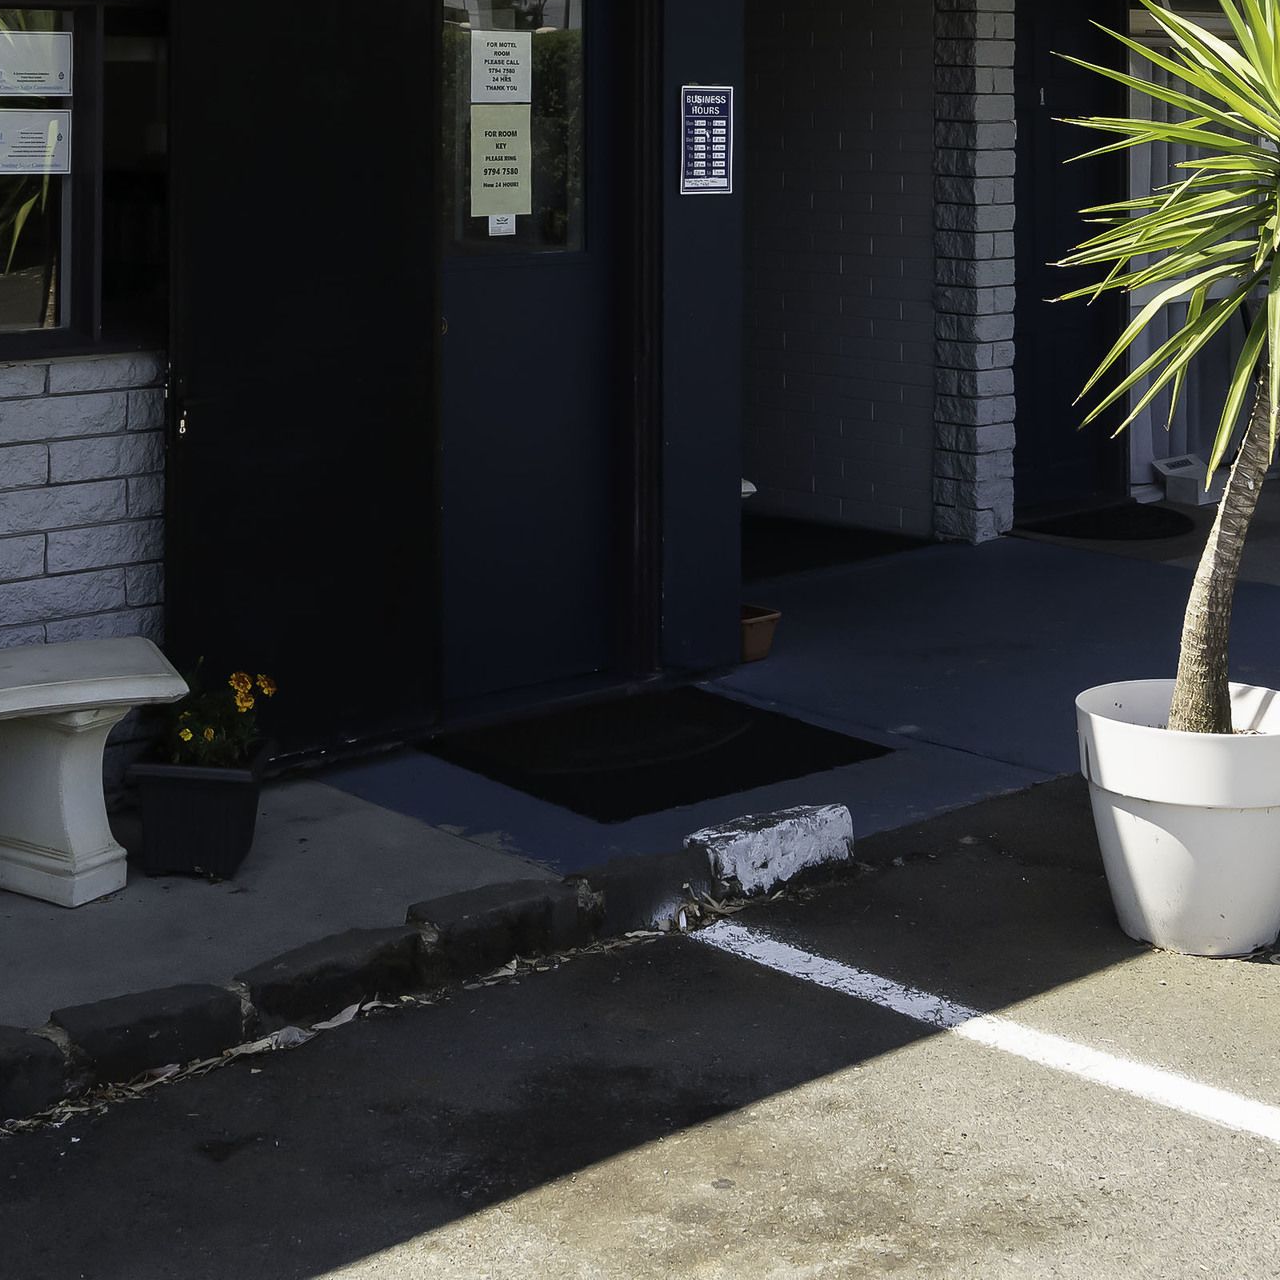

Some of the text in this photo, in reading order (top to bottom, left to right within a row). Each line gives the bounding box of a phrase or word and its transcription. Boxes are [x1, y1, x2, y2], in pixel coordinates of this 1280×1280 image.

[686, 95, 727, 104] BUSINESS
[691, 106, 720, 115] HOURS
[483, 168, 501, 176] 9794
